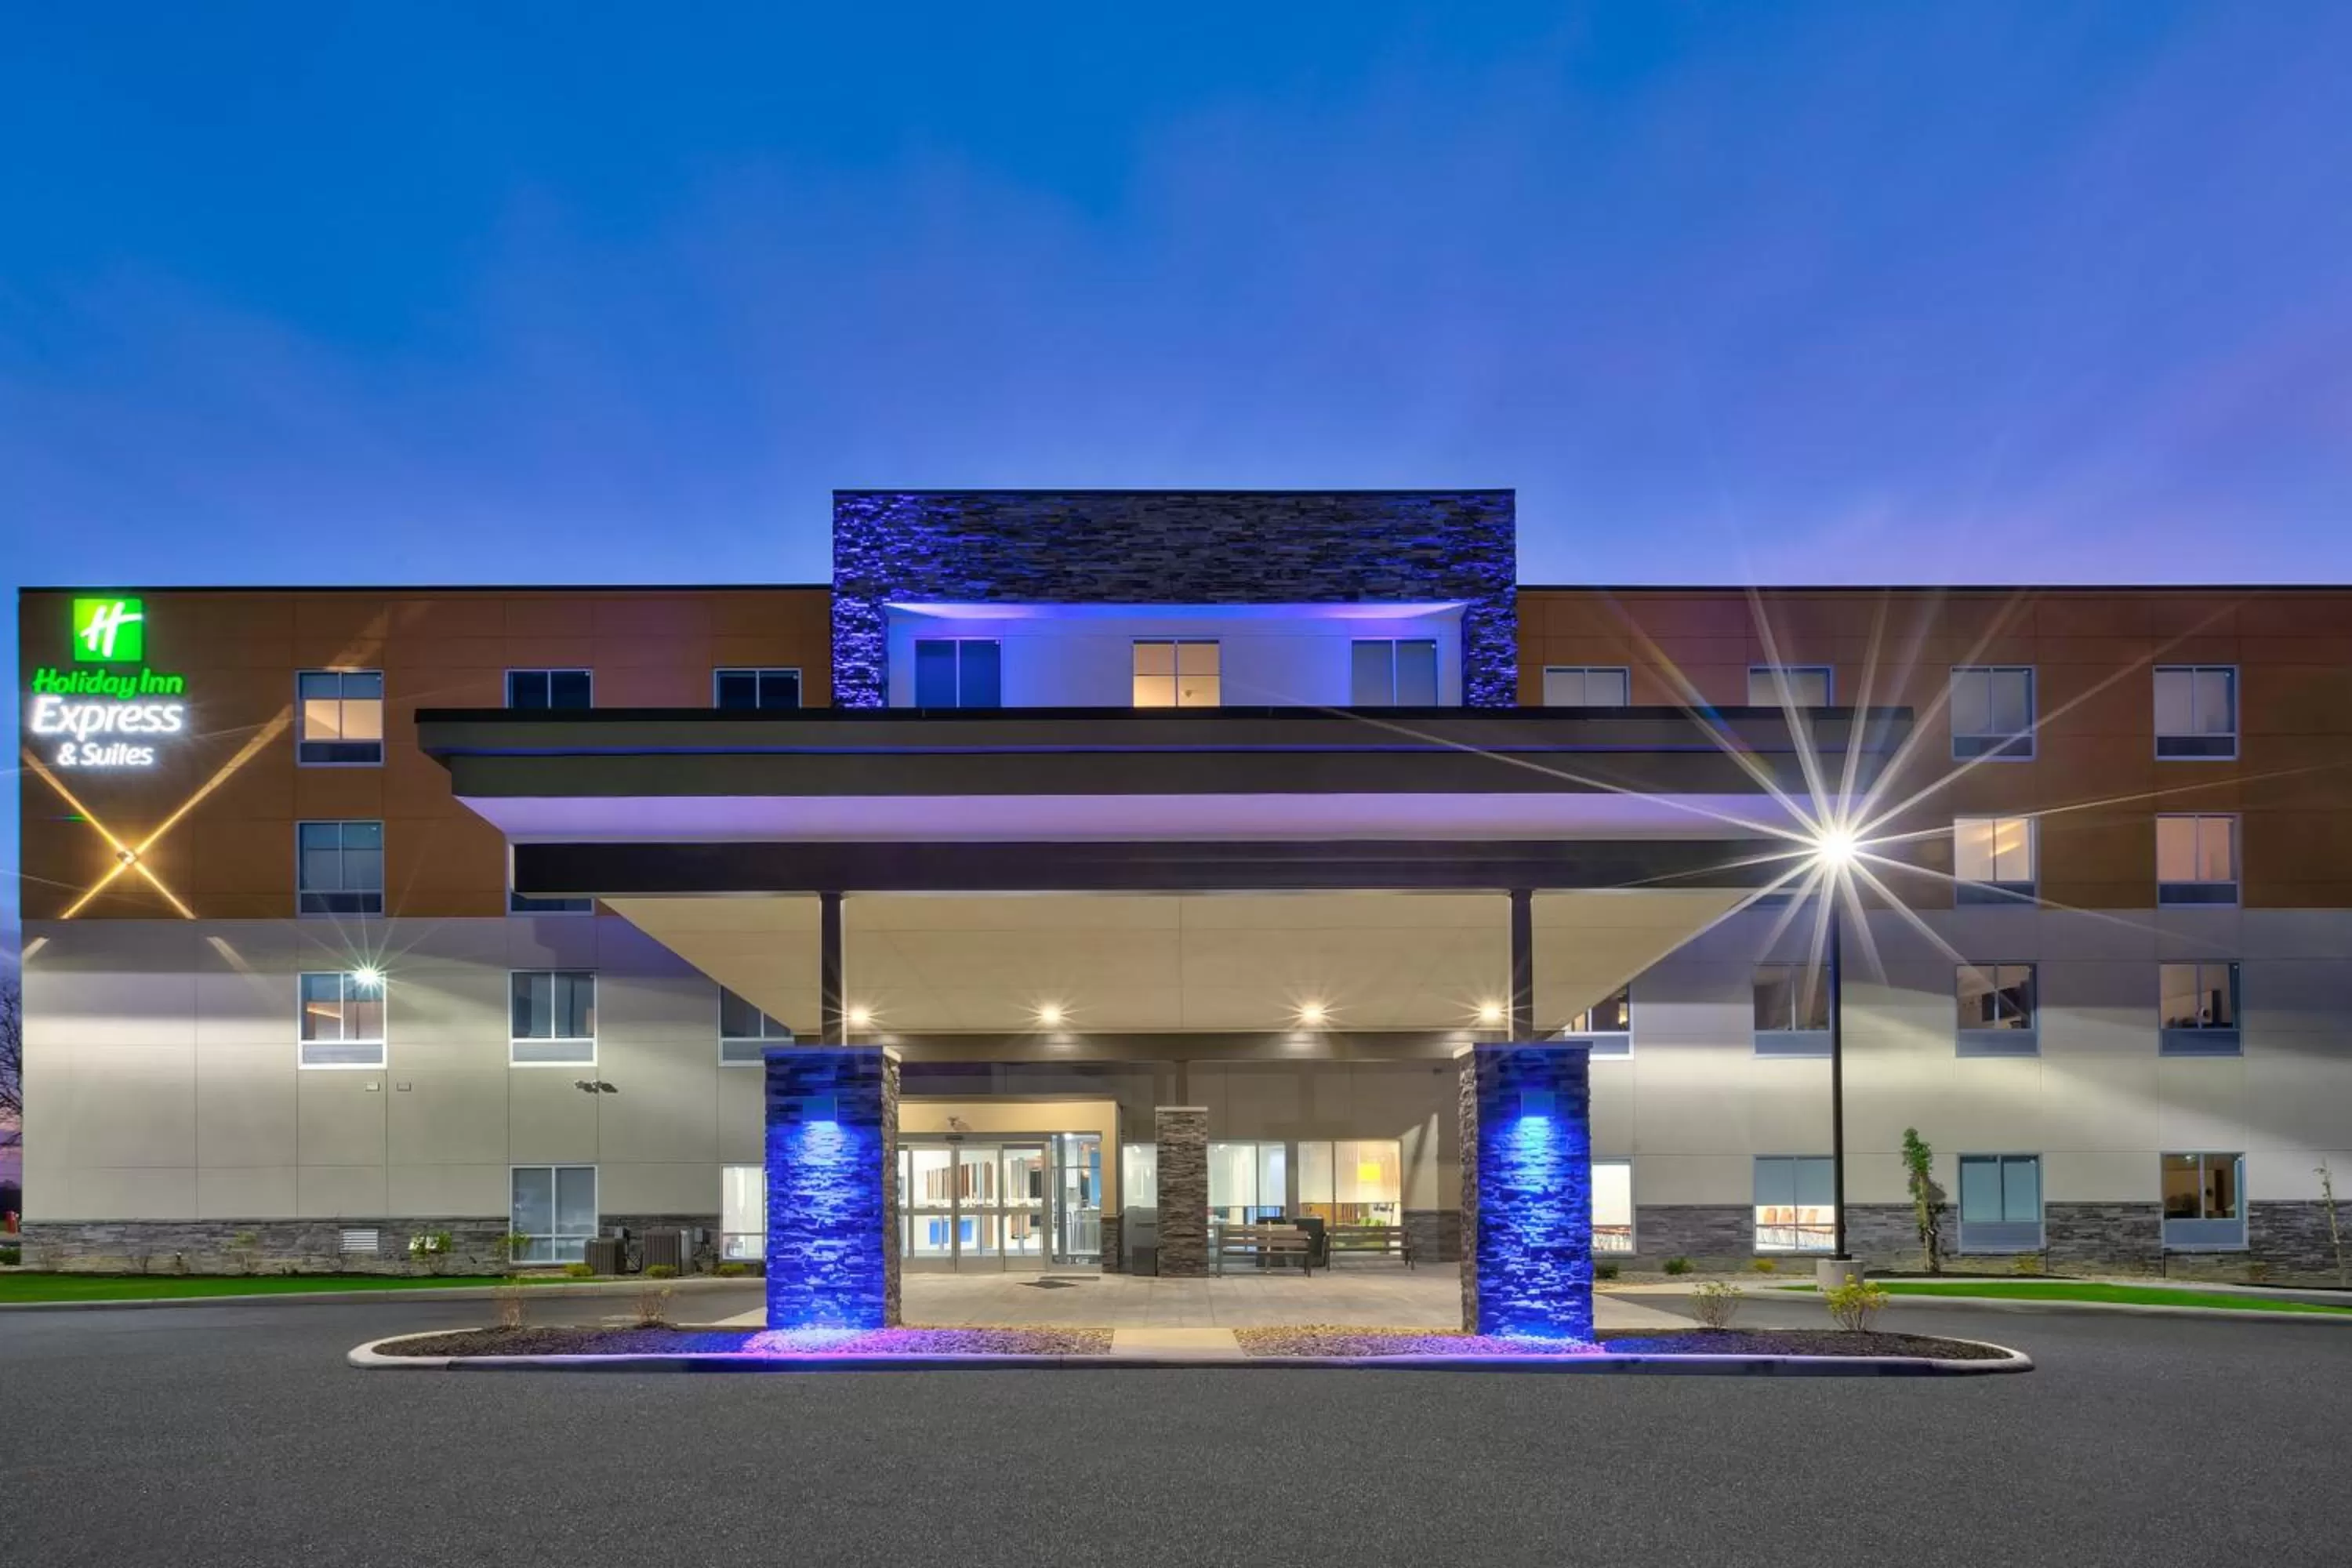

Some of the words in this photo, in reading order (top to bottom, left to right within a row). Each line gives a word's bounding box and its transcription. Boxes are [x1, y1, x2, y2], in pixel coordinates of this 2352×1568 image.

[32, 668, 137, 699] Holiday
[140, 668, 183, 694] Inn
[31, 695, 184, 742] Express
[57, 742, 77, 766] &
[80, 742, 154, 766] Suites
